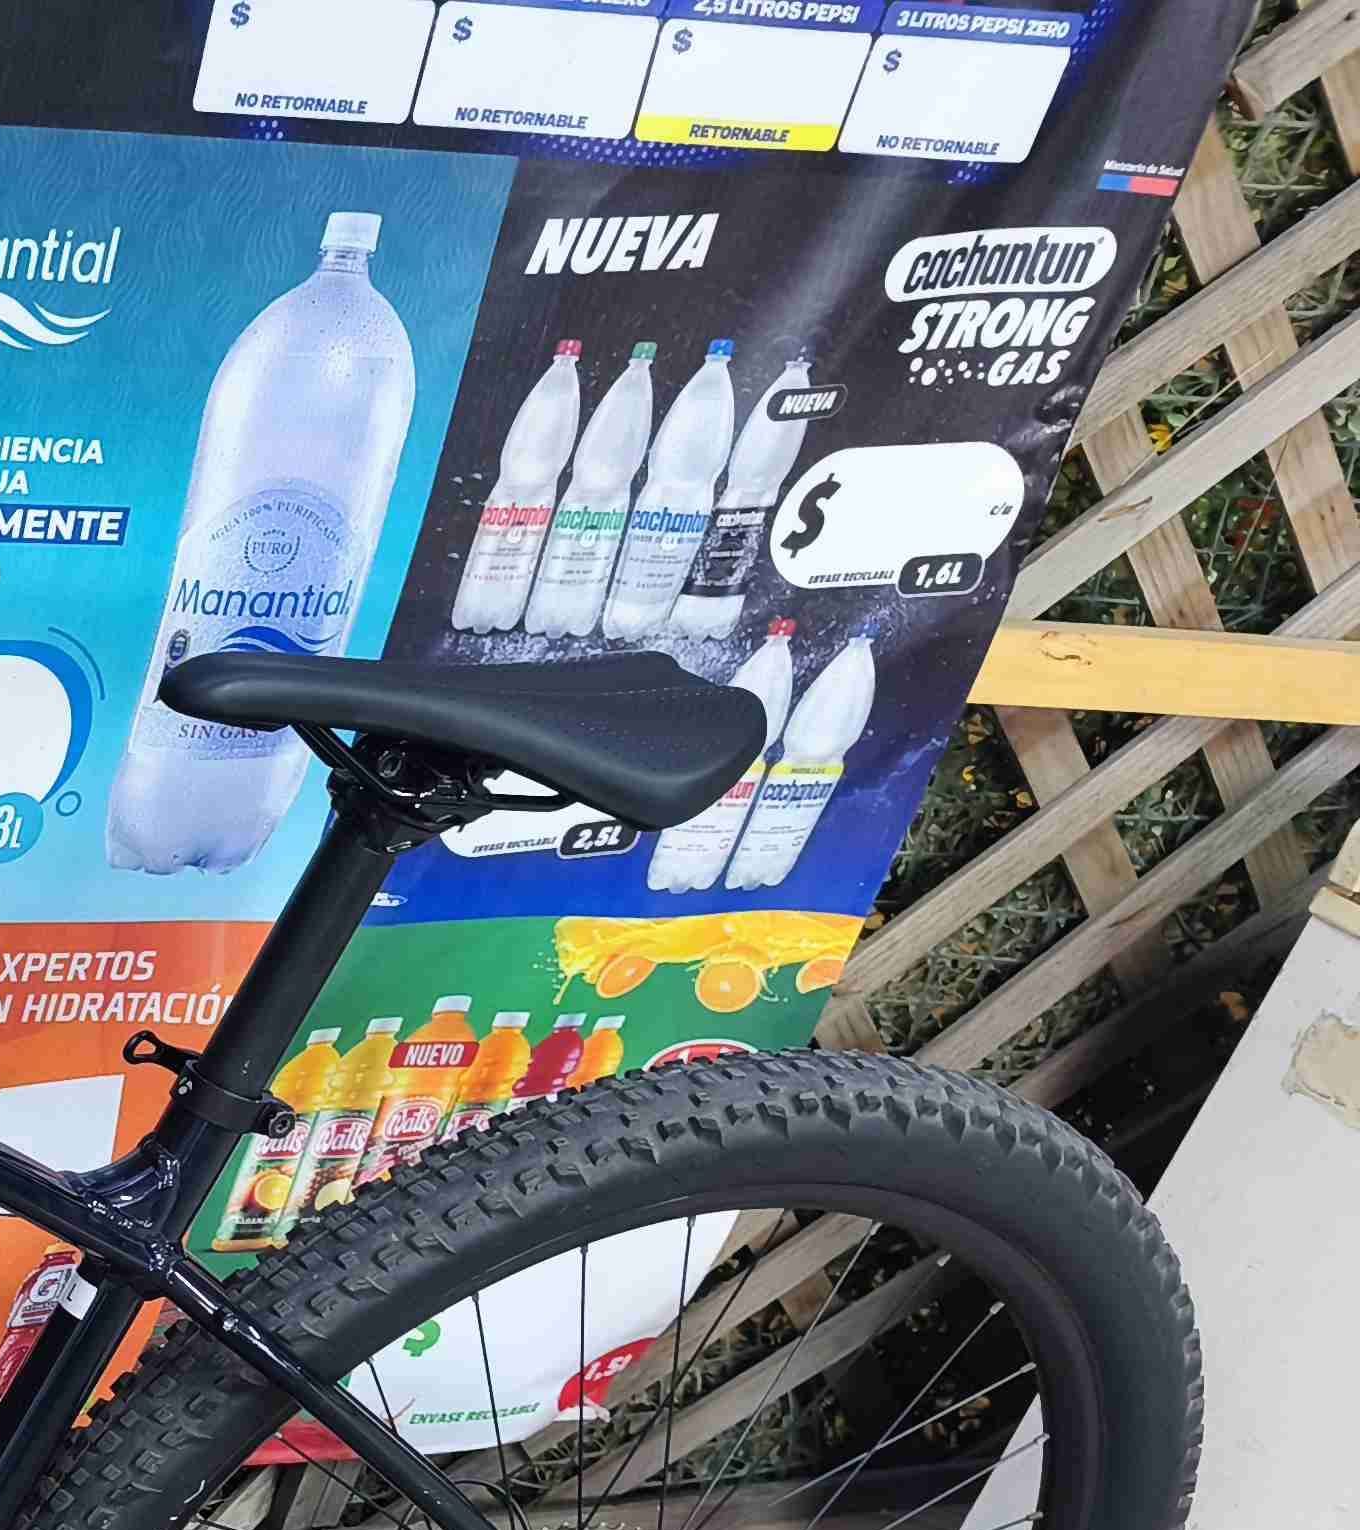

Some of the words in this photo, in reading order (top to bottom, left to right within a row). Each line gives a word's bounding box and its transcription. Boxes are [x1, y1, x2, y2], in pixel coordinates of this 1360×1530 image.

[229, 1, 251, 28] $
[732, 0, 794, 20] LITROS
[797, 3, 859, 23] PEPSI
[896, 10, 909, 27] 3
[910, 11, 969, 32] LITROS
[969, 17, 1025, 36] PEPSI
[1026, 20, 1071, 39] ZERO
[452, 16, 473, 43] $
[671, 25, 693, 54] $
[882, 49, 902, 73] $
[234, 91, 259, 108] NO
[260, 94, 368, 115] RETORNABLE
[454, 106, 481, 122] NO
[481, 108, 588, 130] RETORNABLE
[689, 123, 790, 144] RETORNABLE
[876, 134, 900, 149] NO
[900, 137, 999, 156] RETORNABLE
[524, 213, 720, 275] NUEVA
[902, 234, 1096, 294] cachantun
[898, 297, 1096, 353] STRONG
[987, 350, 1071, 386] GAS
[779, 391, 838, 414] NUEVA
[780, 472, 842, 559] $
[251, 541, 293, 556] PURO
[914, 561, 964, 589] 1,6L
[172, 578, 353, 619] Manantial
[177, 722, 215, 739] SIN
[572, 825, 622, 850] 2,5L
[20, 984, 234, 1026] HIDRATACIÓ
[402, 1043, 465, 1067] NUEVO
[408, 1411, 465, 1425] ENVASE
